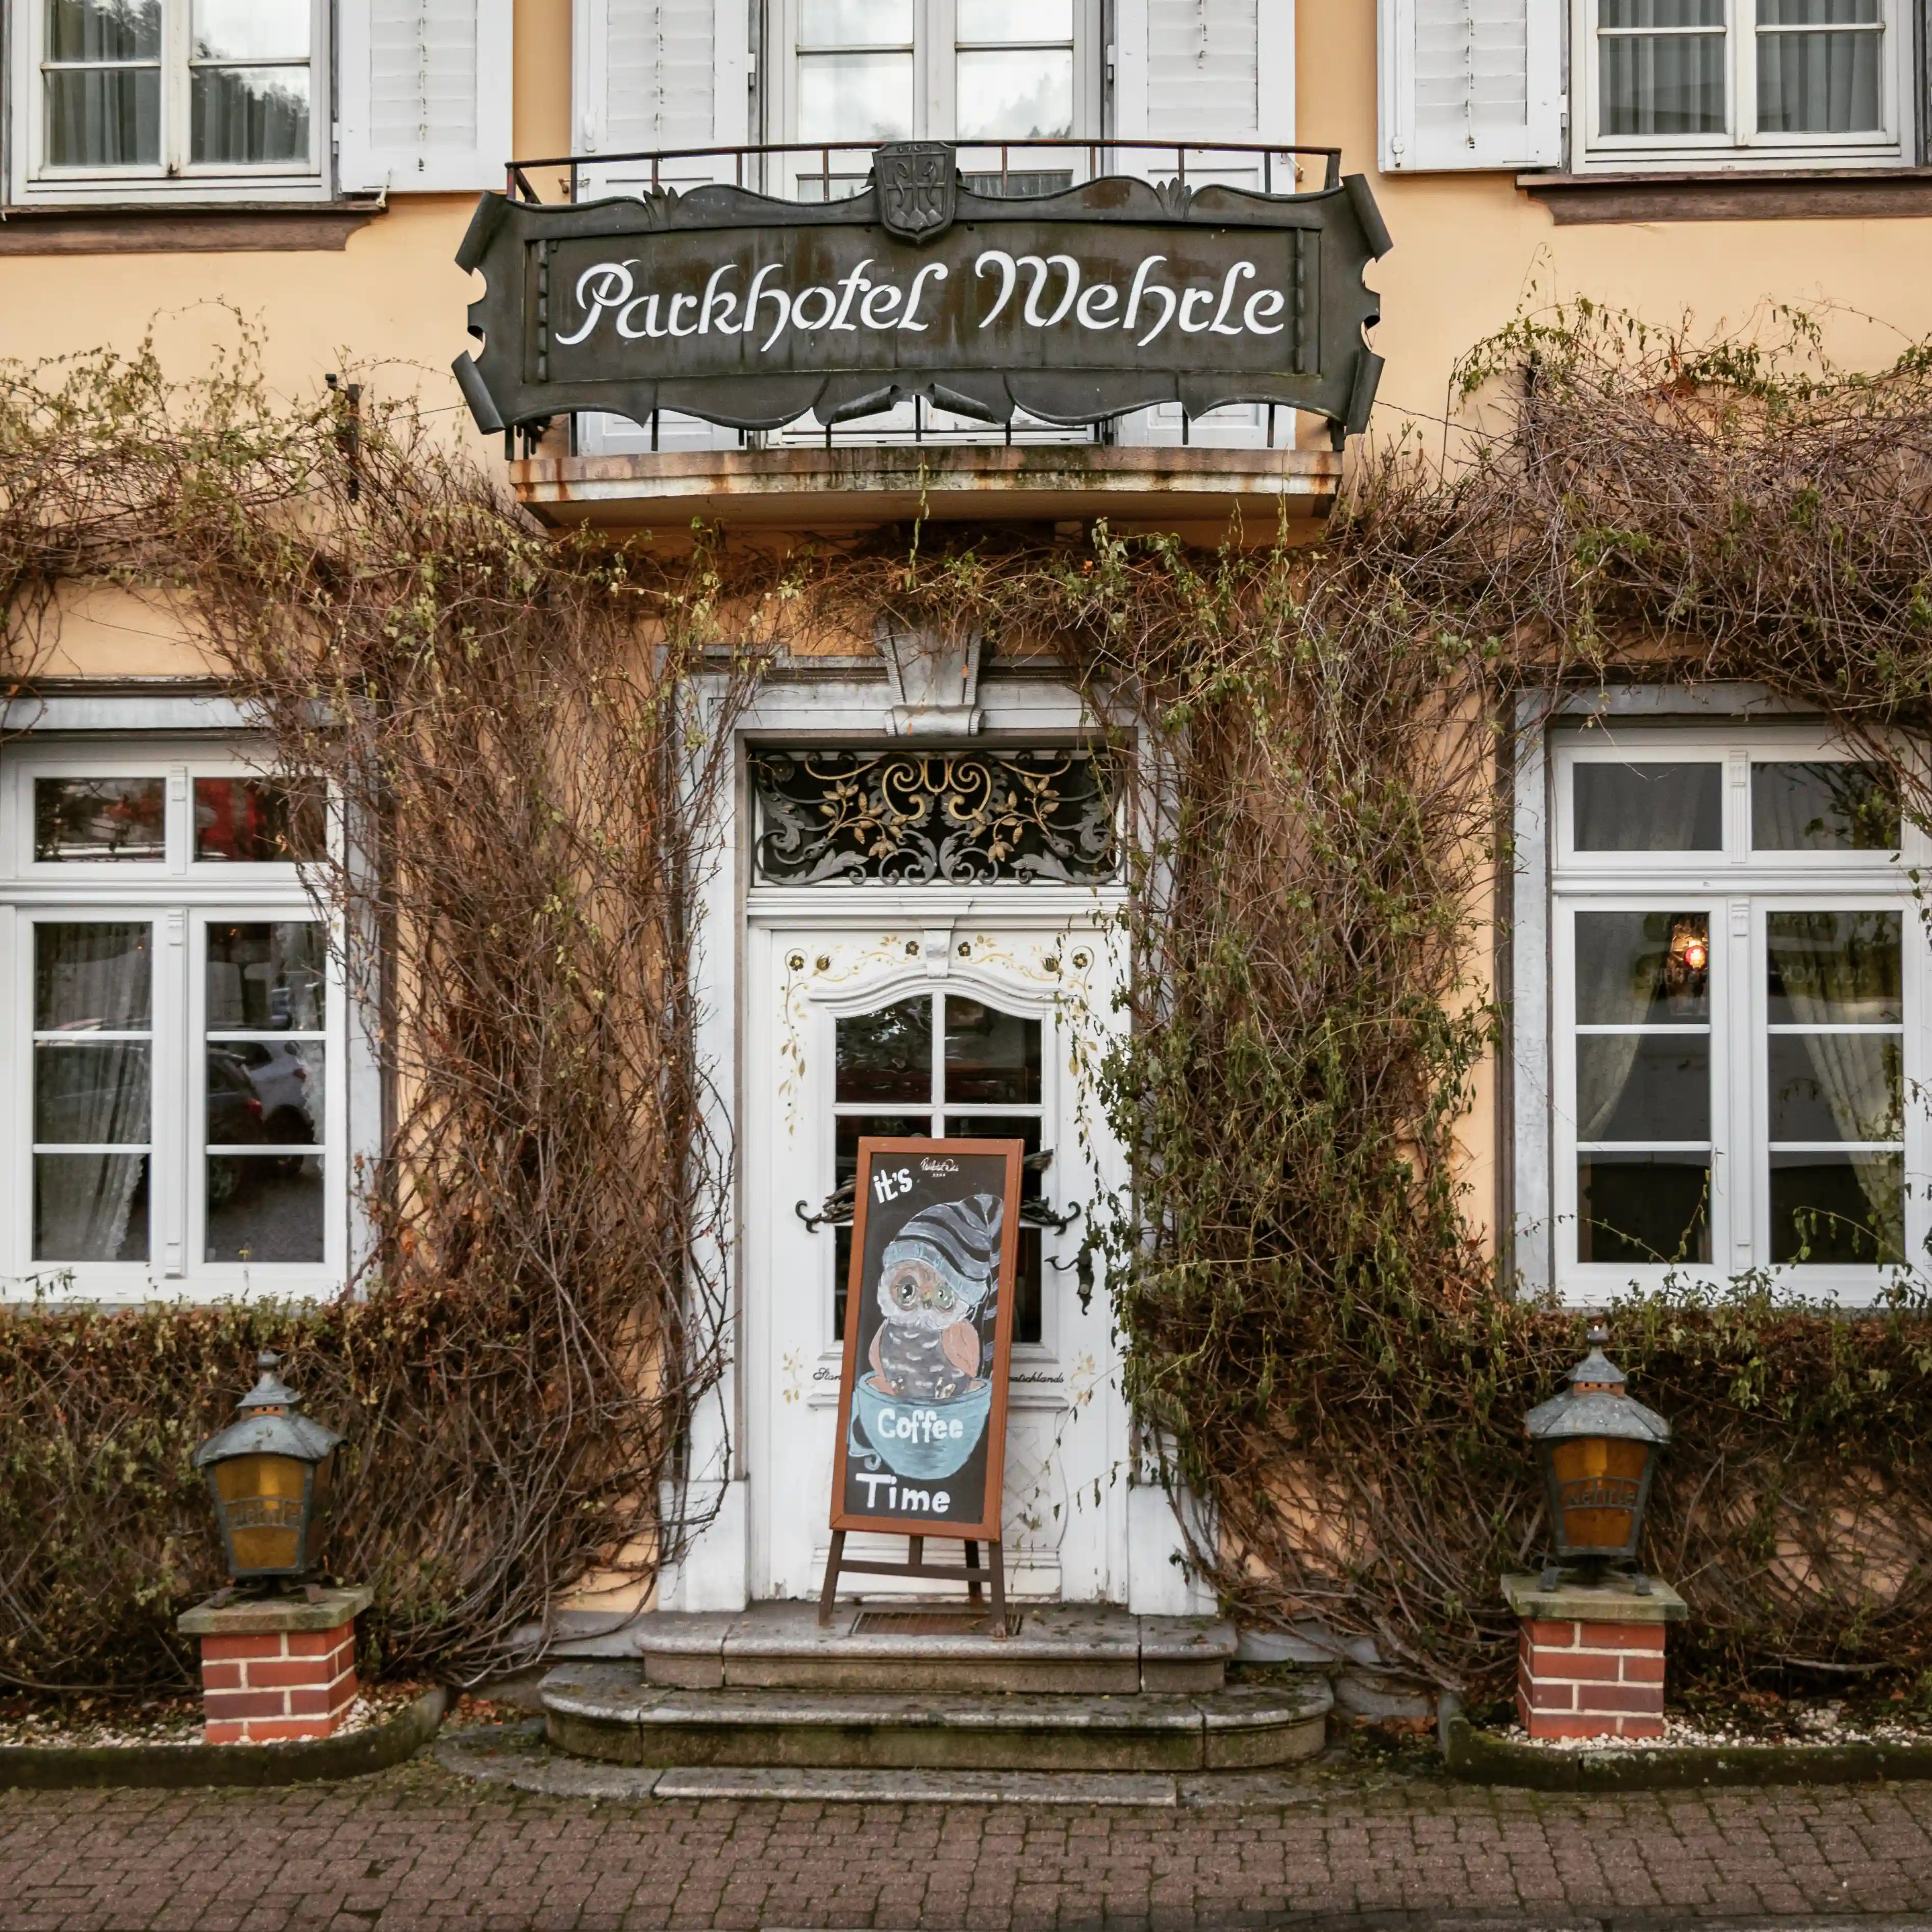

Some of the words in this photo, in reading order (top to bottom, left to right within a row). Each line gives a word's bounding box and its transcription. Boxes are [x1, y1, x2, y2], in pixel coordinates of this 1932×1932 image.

[555, 259, 949, 352] Parkhotel
[974, 249, 1285, 346] Wehrle
[873, 1168, 913, 1203] it's
[877, 1408, 964, 1443] Coffee
[855, 1472, 951, 1513] Time
